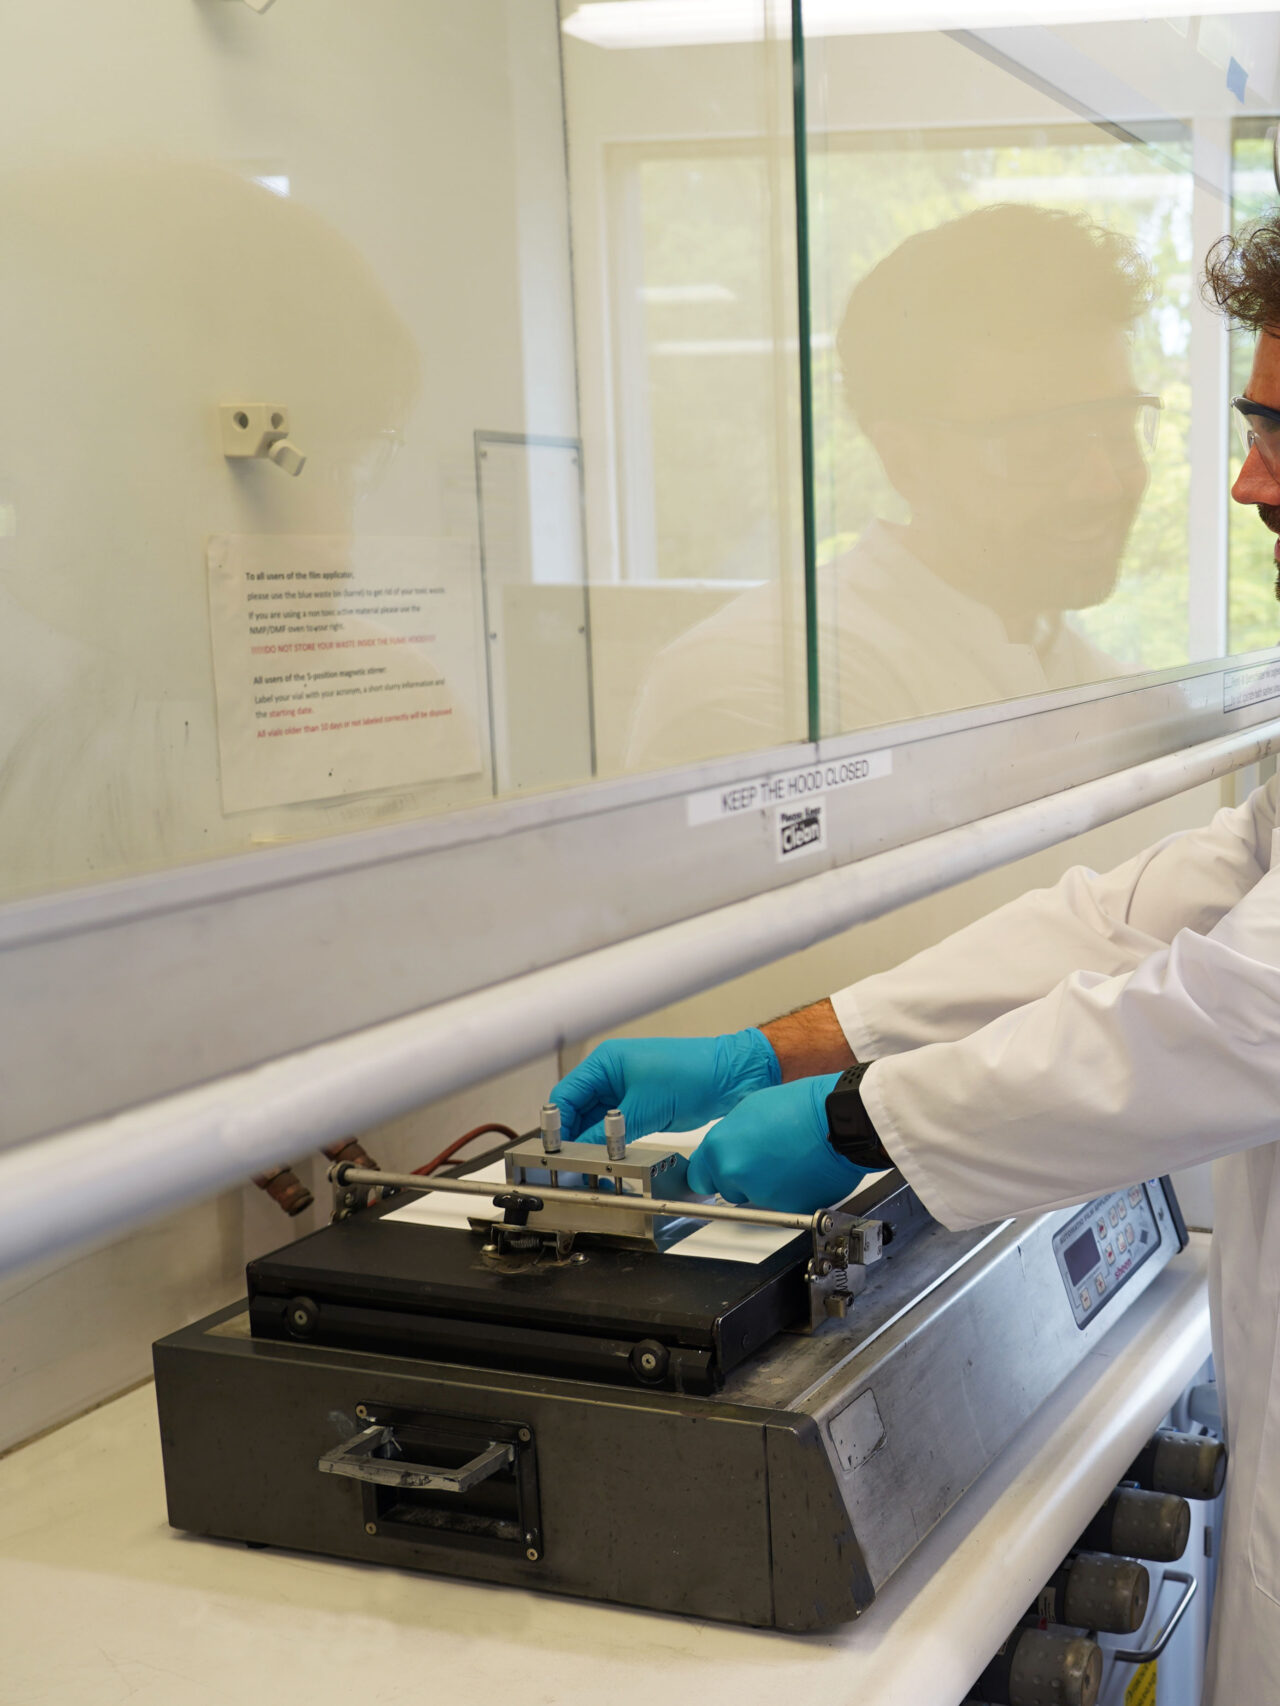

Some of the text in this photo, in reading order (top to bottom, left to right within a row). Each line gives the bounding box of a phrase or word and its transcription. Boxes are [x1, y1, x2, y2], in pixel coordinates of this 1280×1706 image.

[246, 572, 256, 580] To
[257, 571, 265, 580] all
[267, 572, 285, 580] users
[287, 571, 295, 580] of
[296, 571, 307, 579] the
[309, 570, 321, 579] film
[278, 642, 292, 653] NOT
[294, 641, 315, 652] STORE
[317, 640, 334, 650] YOUR
[336, 639, 355, 649] WASTE
[358, 638, 376, 647] INSIDE
[377, 636, 388, 646] THE
[254, 675, 263, 684] All
[264, 675, 284, 684] users
[285, 673, 292, 682] of
[293, 672, 305, 681] the
[339, 667, 366, 678] magnetic
[255, 710, 268, 719] the
[269, 708, 296, 718] starting
[257, 729, 266, 738] All
[268, 727, 283, 737] vials
[284, 726, 302, 735] older
[303, 724, 320, 733] than
[321, 722, 329, 731] 10
[330, 721, 343, 730] days
[344, 720, 350, 728] or
[351, 719, 362, 727] not
[384, 713, 409, 722] correctly
[410, 711, 420, 719] will
[421, 710, 428, 718] be
[721, 759, 869, 812] KEEP THE HOOD CLOSED
